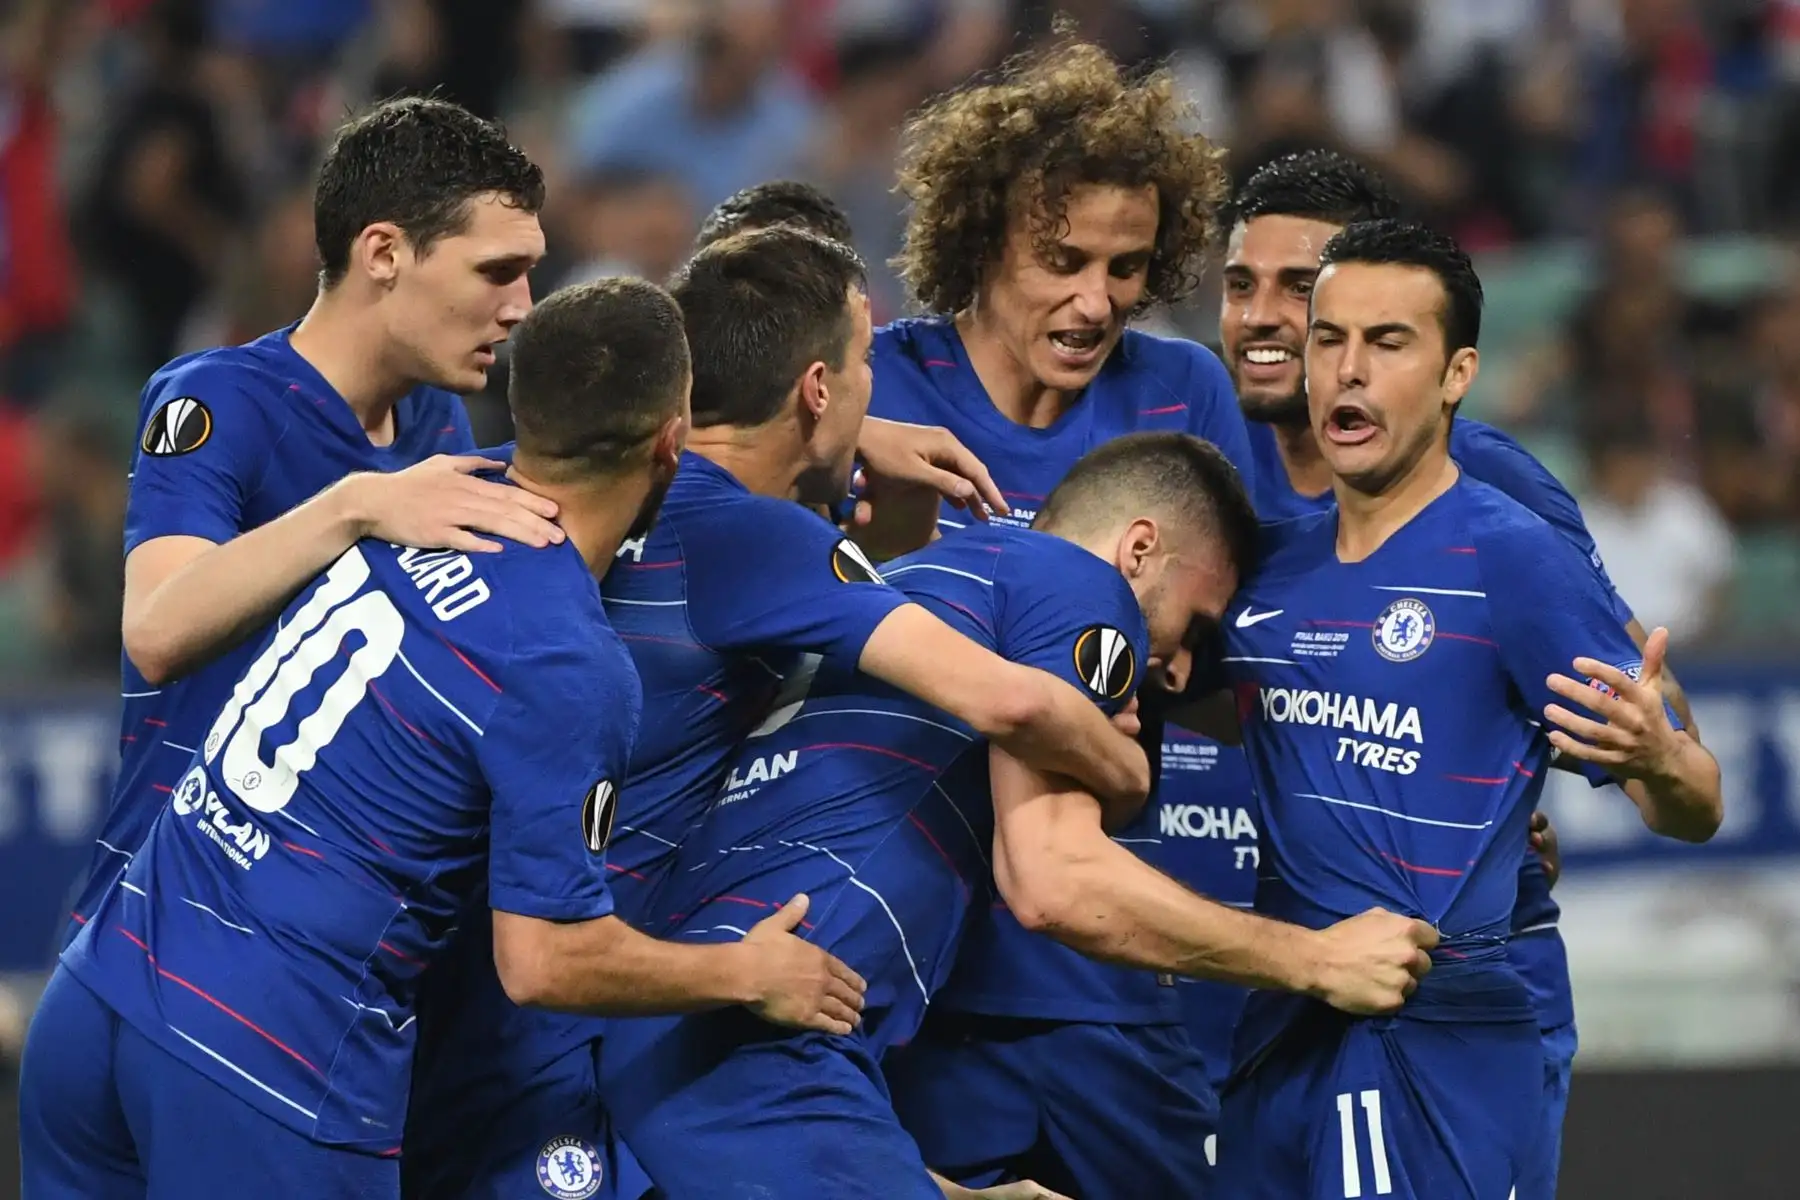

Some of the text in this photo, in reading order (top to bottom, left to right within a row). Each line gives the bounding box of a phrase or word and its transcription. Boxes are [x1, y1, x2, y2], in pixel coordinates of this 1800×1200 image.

[390, 544, 490, 621] ZARD
[1390, 601, 1428, 618] CHELSEA
[204, 545, 404, 813] 10
[1260, 688, 1423, 743] YOKOHAMA
[721, 750, 798, 791] LAN
[1336, 737, 1421, 775] TYRES
[197, 818, 253, 871] INTERNATIONAL
[205, 791, 270, 860] PLAN
[543, 1138, 582, 1158] CHELSEA
[1337, 1089, 1392, 1198] 11
